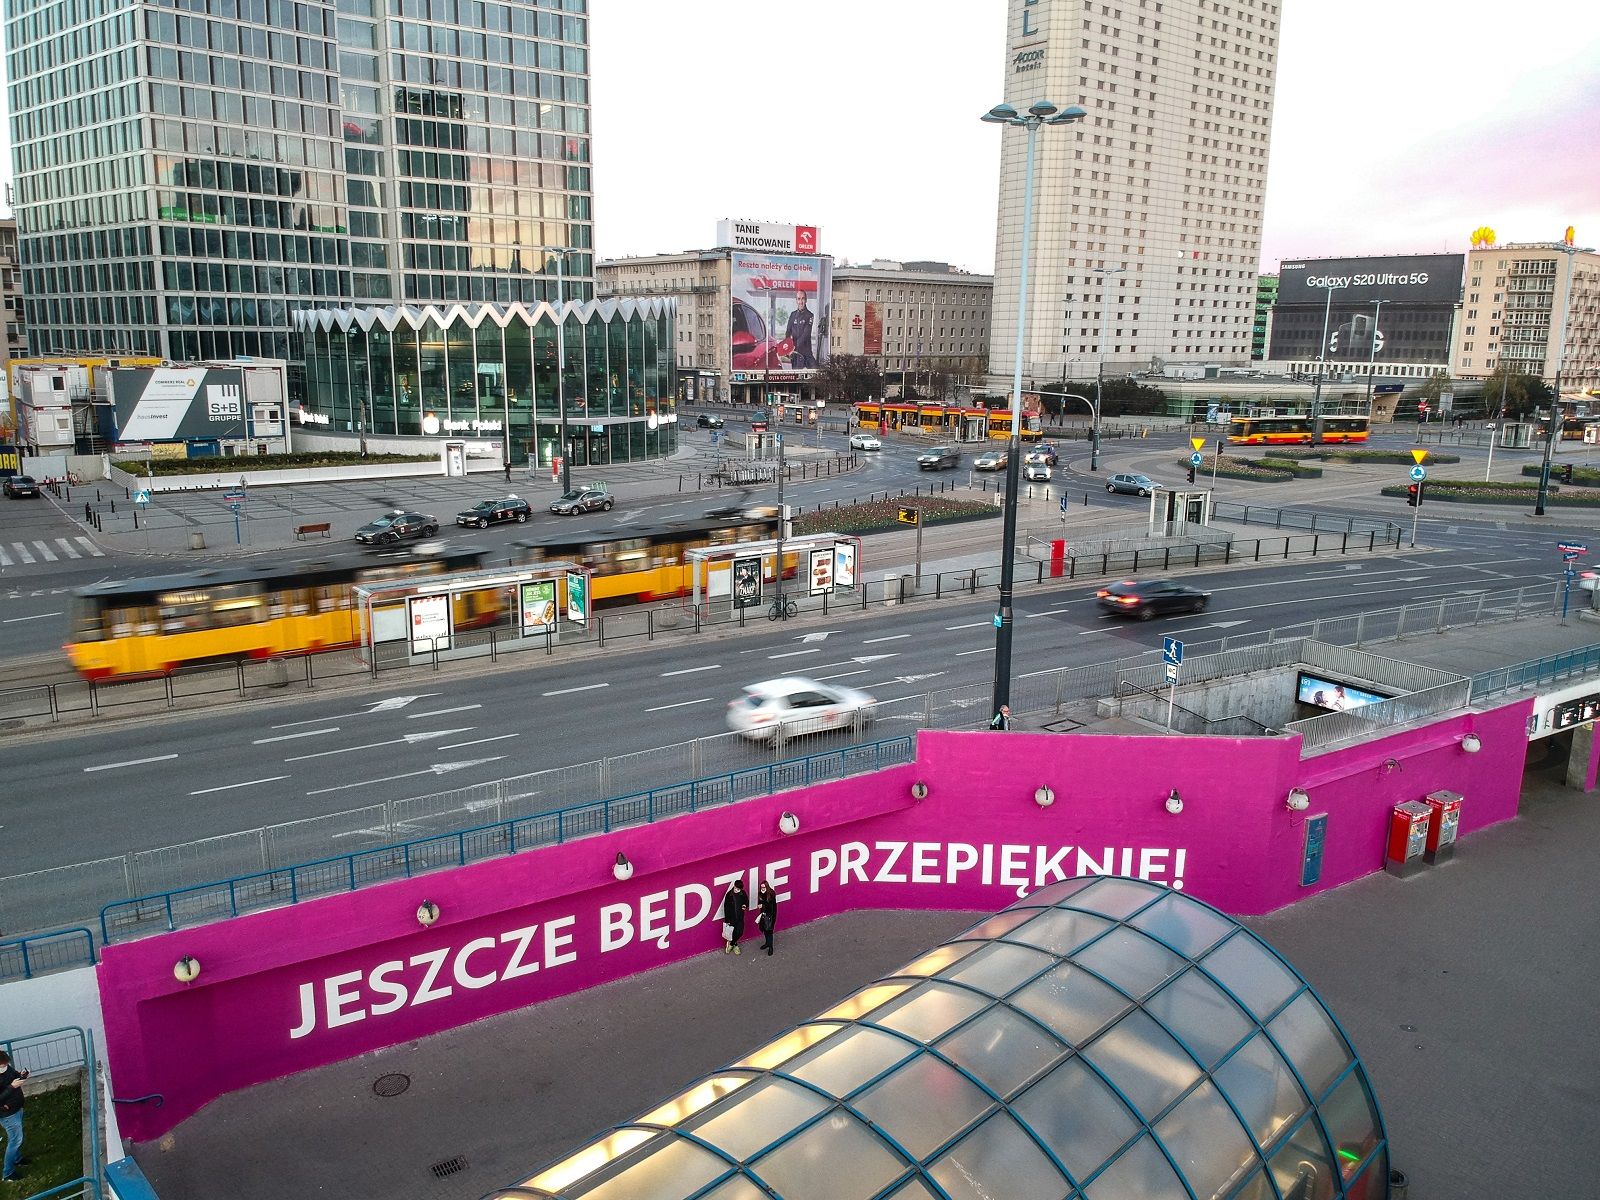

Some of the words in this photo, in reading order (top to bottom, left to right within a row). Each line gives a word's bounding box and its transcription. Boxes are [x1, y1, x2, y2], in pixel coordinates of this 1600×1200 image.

[735, 224, 760, 234] TANIE
[735, 236, 791, 248] TANKOWANIE
[738, 260, 760, 269] Reszta
[760, 263, 782, 272] należy
[783, 263, 792, 271] do
[793, 264, 813, 272] Ciebie
[771, 280, 796, 289] ORLEN
[1306, 274, 1352, 288] Galaxy
[1353, 274, 1376, 286] S20
[1376, 273, 1408, 285] Ultra
[1409, 272, 1429, 285] 5G
[211, 403, 238, 413] S+B
[290, 915, 577, 1039] JESZCZE
[600, 857, 792, 950] BĘDZIE
[809, 841, 1187, 899] PRZEPIĘKNIE!
